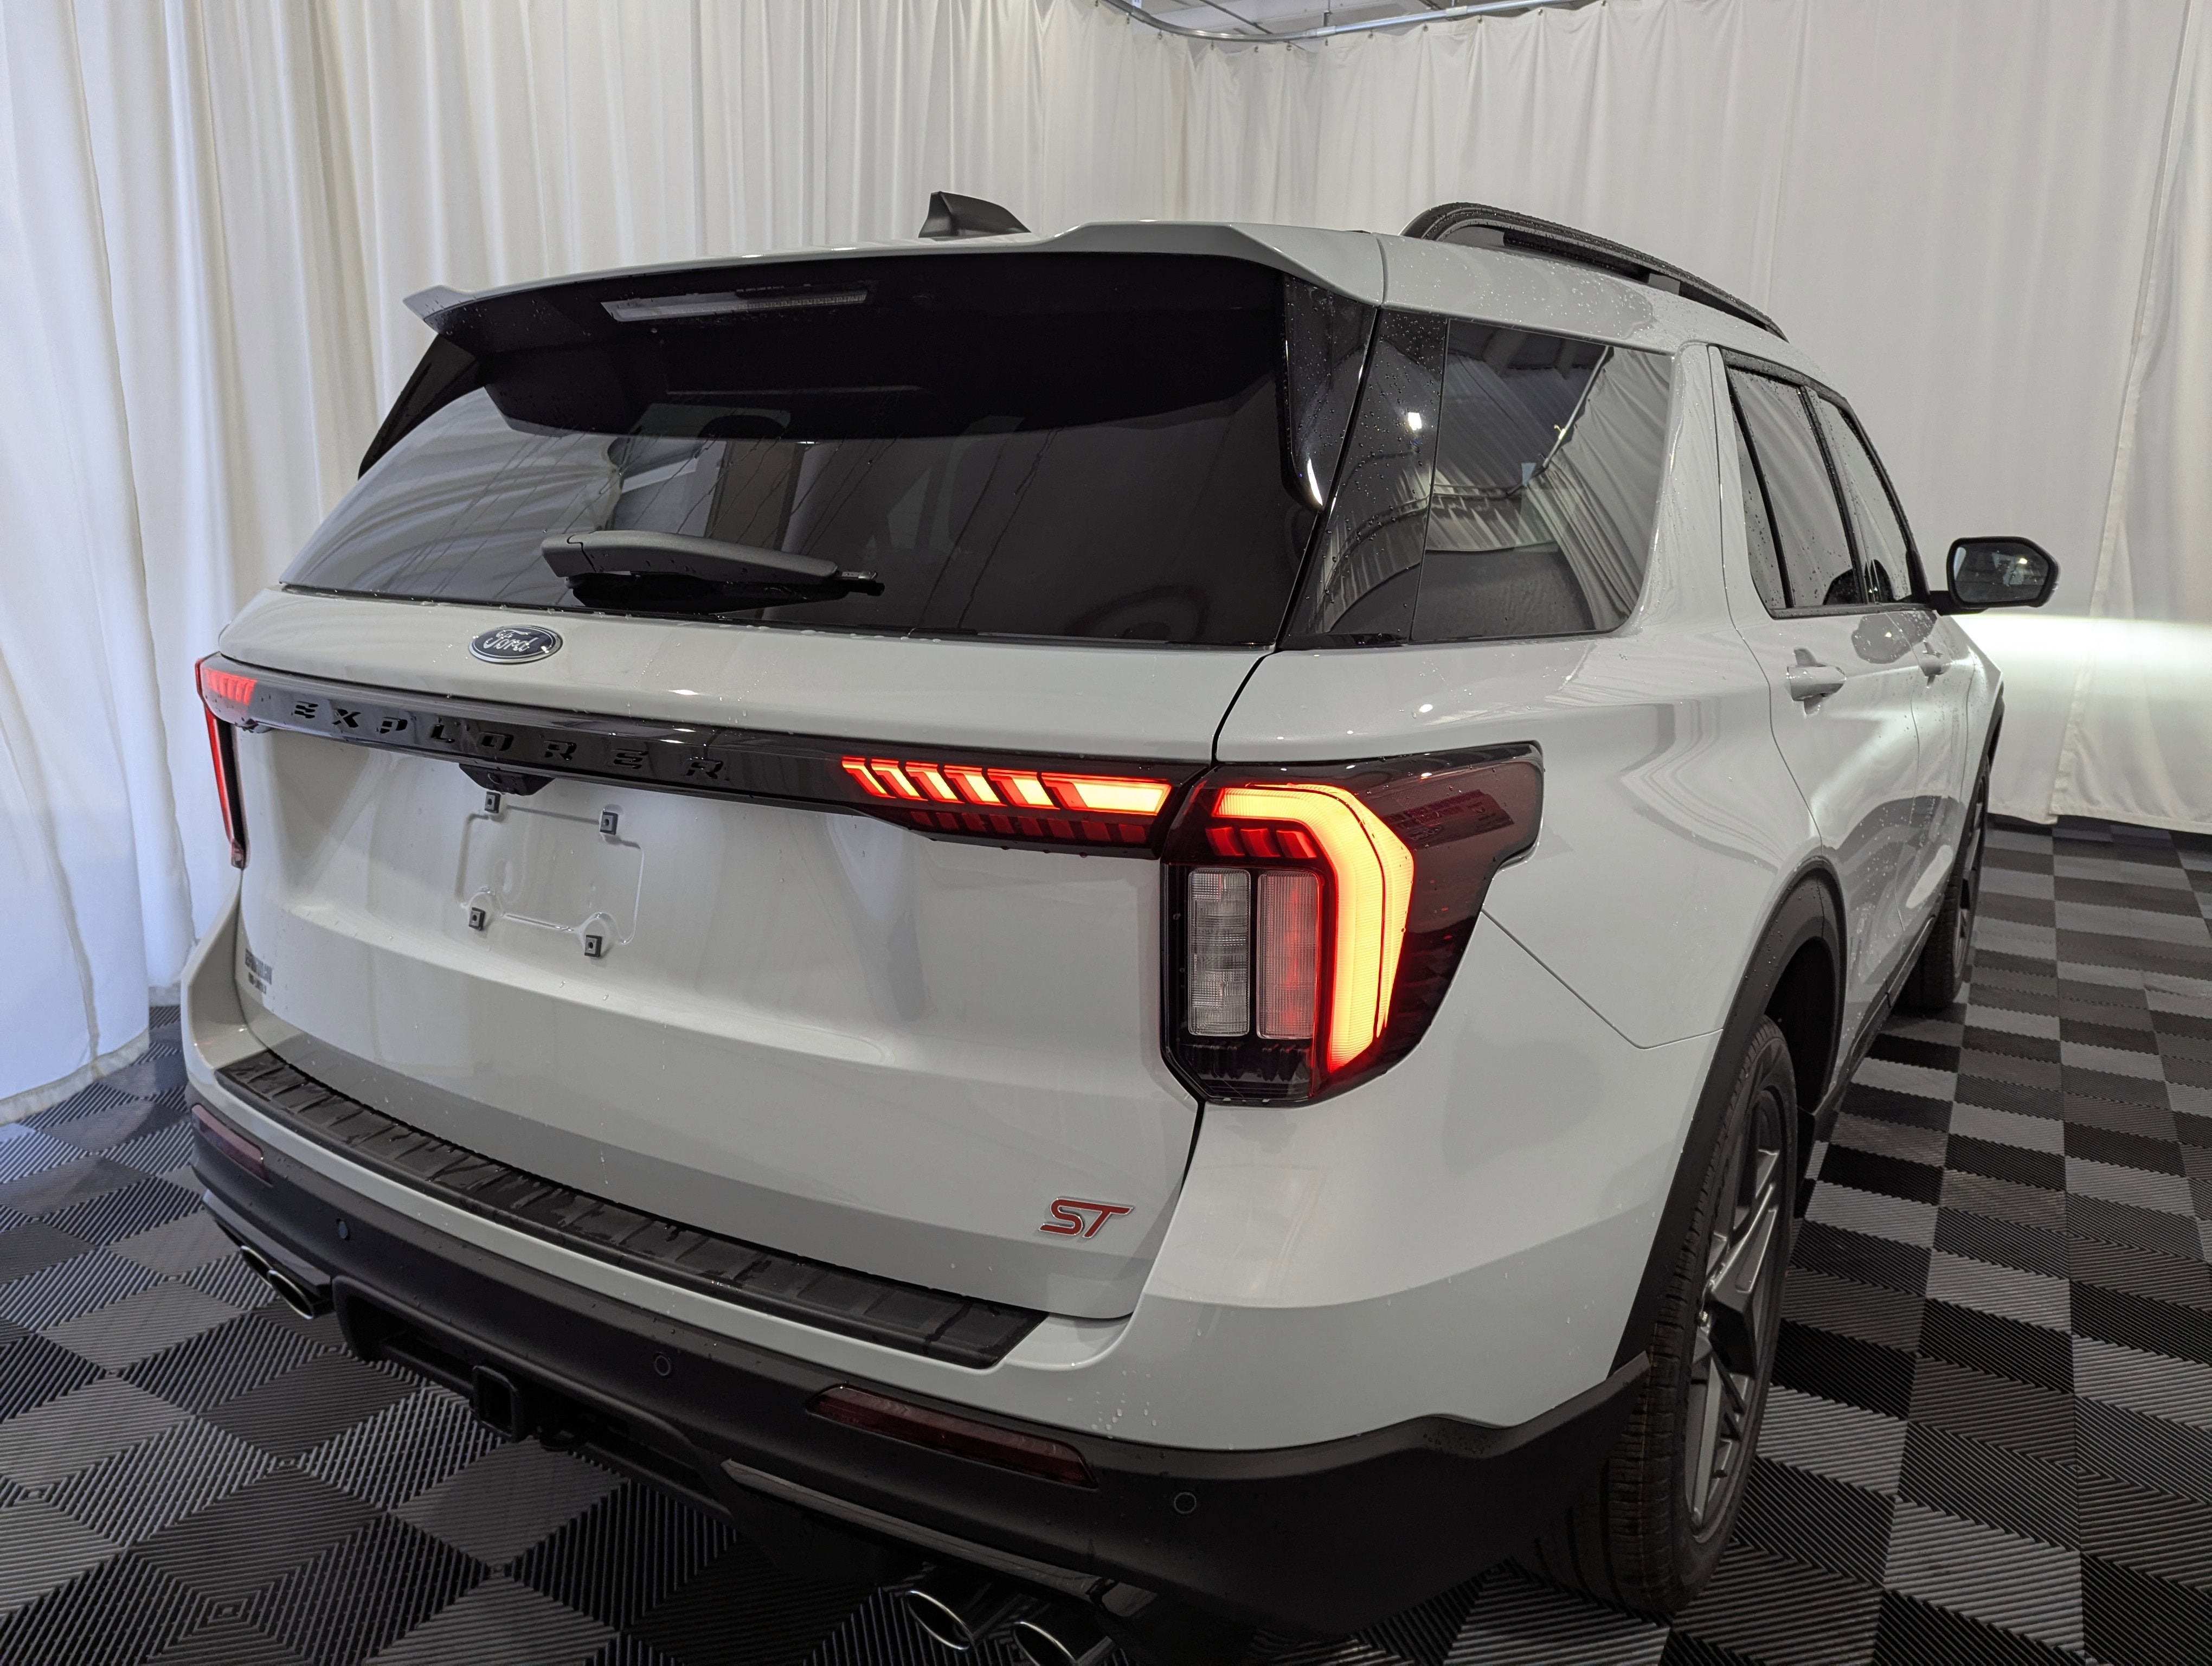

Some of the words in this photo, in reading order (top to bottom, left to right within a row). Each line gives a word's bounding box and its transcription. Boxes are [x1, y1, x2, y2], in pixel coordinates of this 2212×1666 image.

[483, 629, 532, 652] Ford
[294, 701, 726, 781] EXPLORER
[1038, 1197, 1134, 1239] ST
